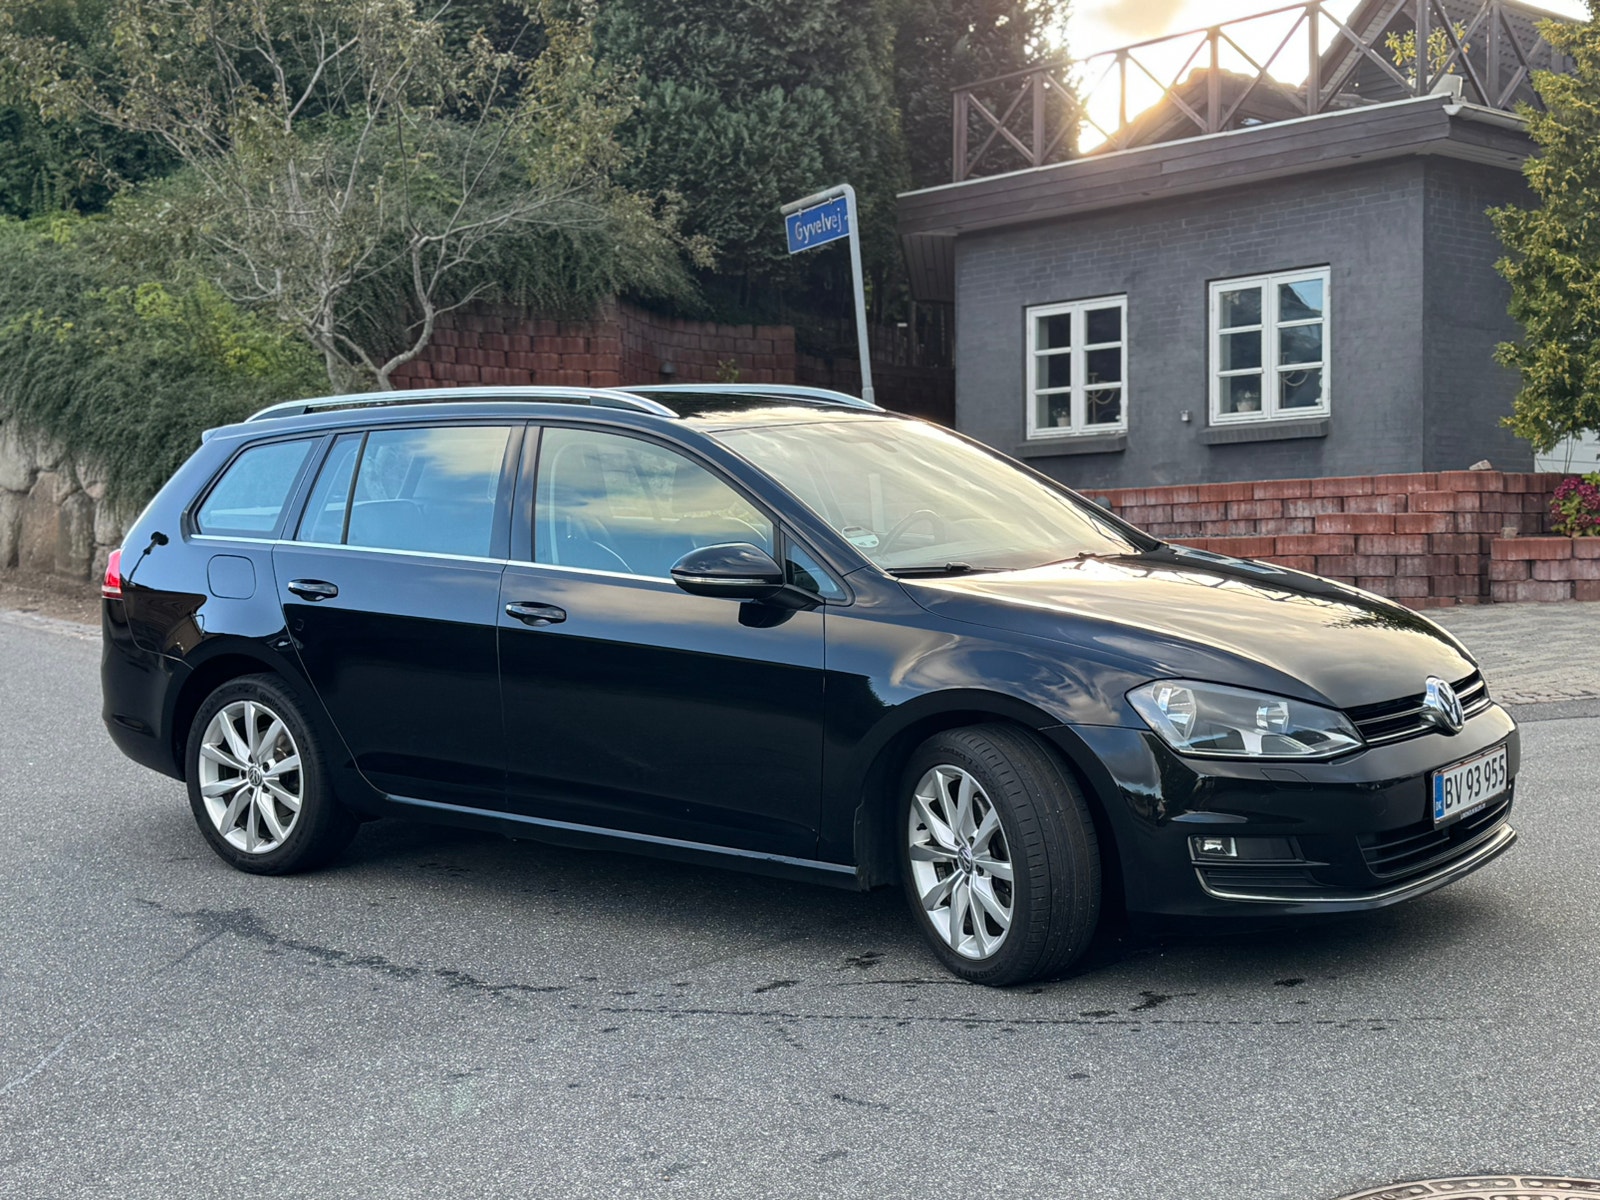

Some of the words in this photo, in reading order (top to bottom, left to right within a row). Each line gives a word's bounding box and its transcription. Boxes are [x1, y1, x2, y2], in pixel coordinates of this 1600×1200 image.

[795, 207, 842, 244] Gyvelvej
[1445, 772, 1463, 809] BV
[1466, 766, 1481, 800] 93
[1484, 754, 1505, 792] 955
